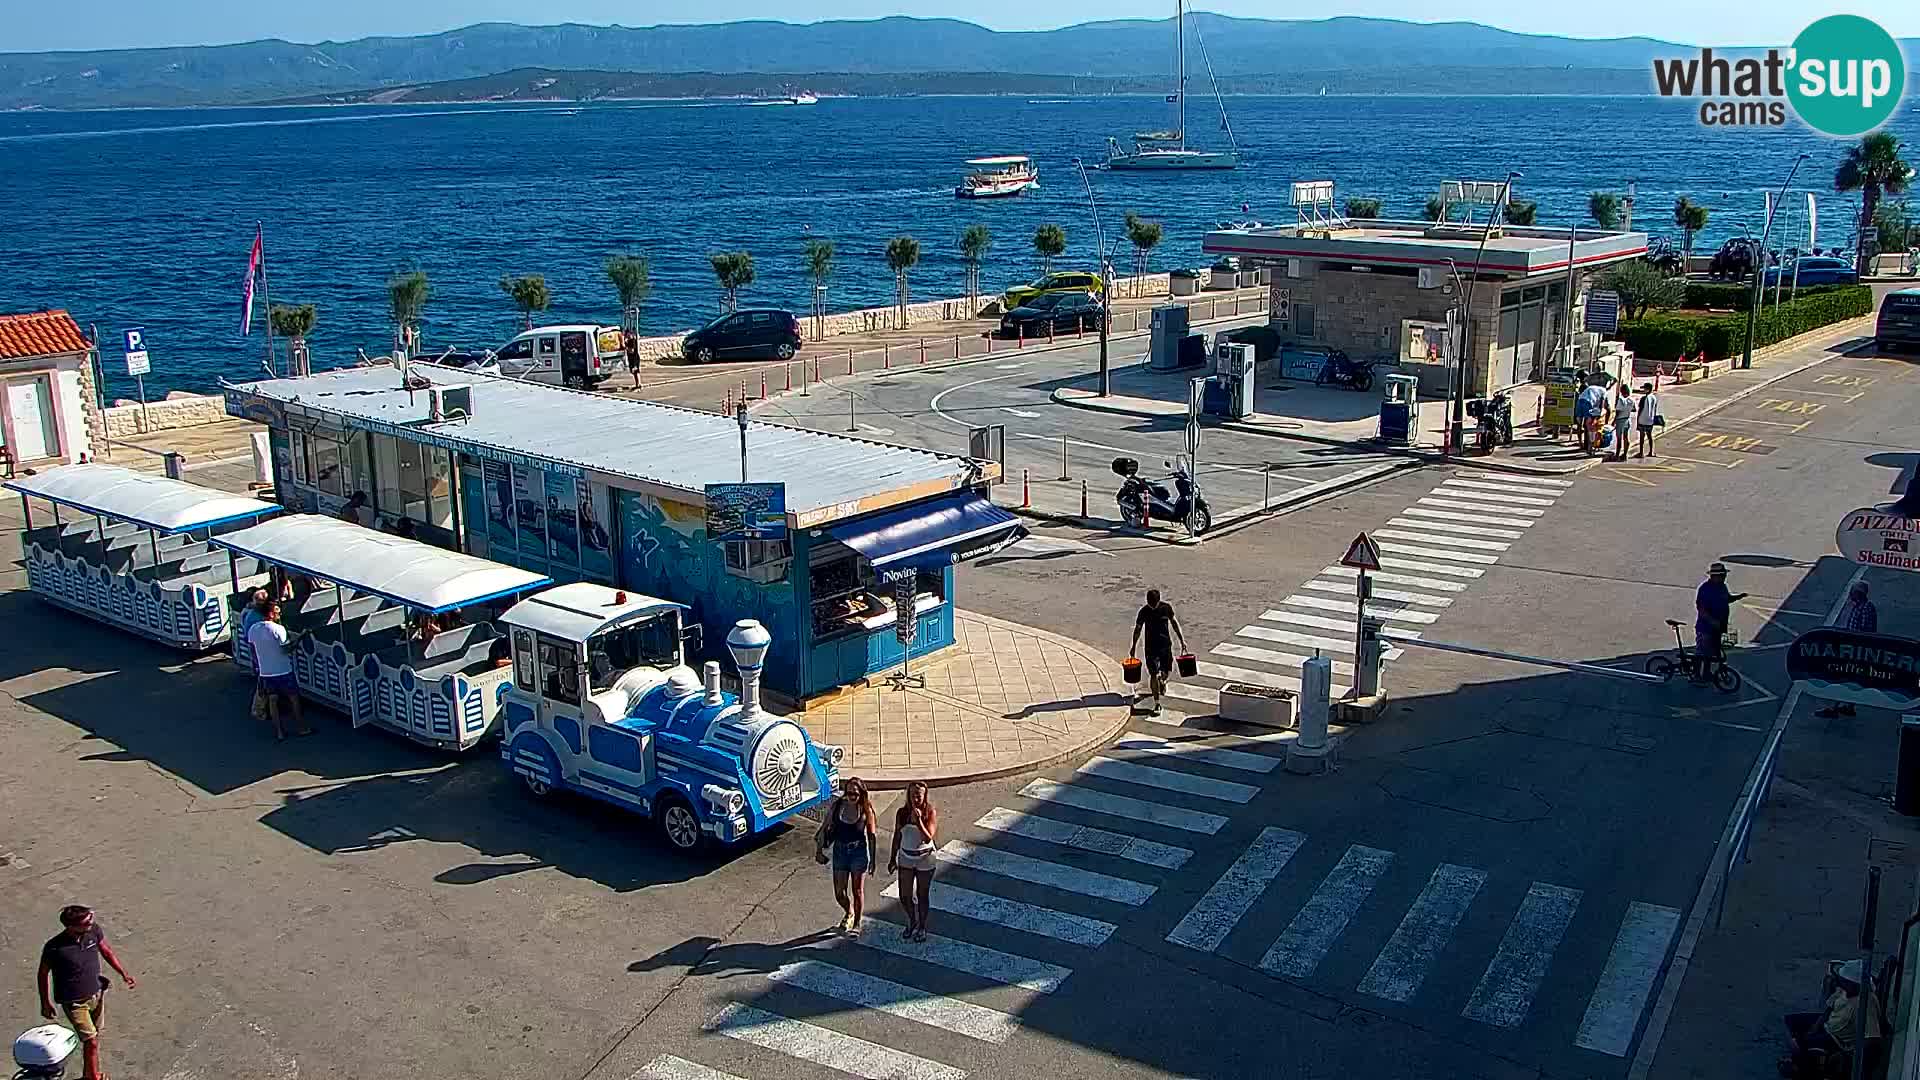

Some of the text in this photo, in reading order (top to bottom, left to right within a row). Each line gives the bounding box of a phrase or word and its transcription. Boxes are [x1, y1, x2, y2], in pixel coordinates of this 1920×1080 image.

[128, 331, 142, 350] P
[1812, 374, 1880, 388] TAXI
[1756, 399, 1828, 414] TAXI
[1684, 433, 1764, 451] TAXI
[477, 446, 492, 459] BUS
[492, 450, 525, 465] STATION
[527, 457, 552, 471] TICKET
[554, 462, 581, 477] OFFICE
